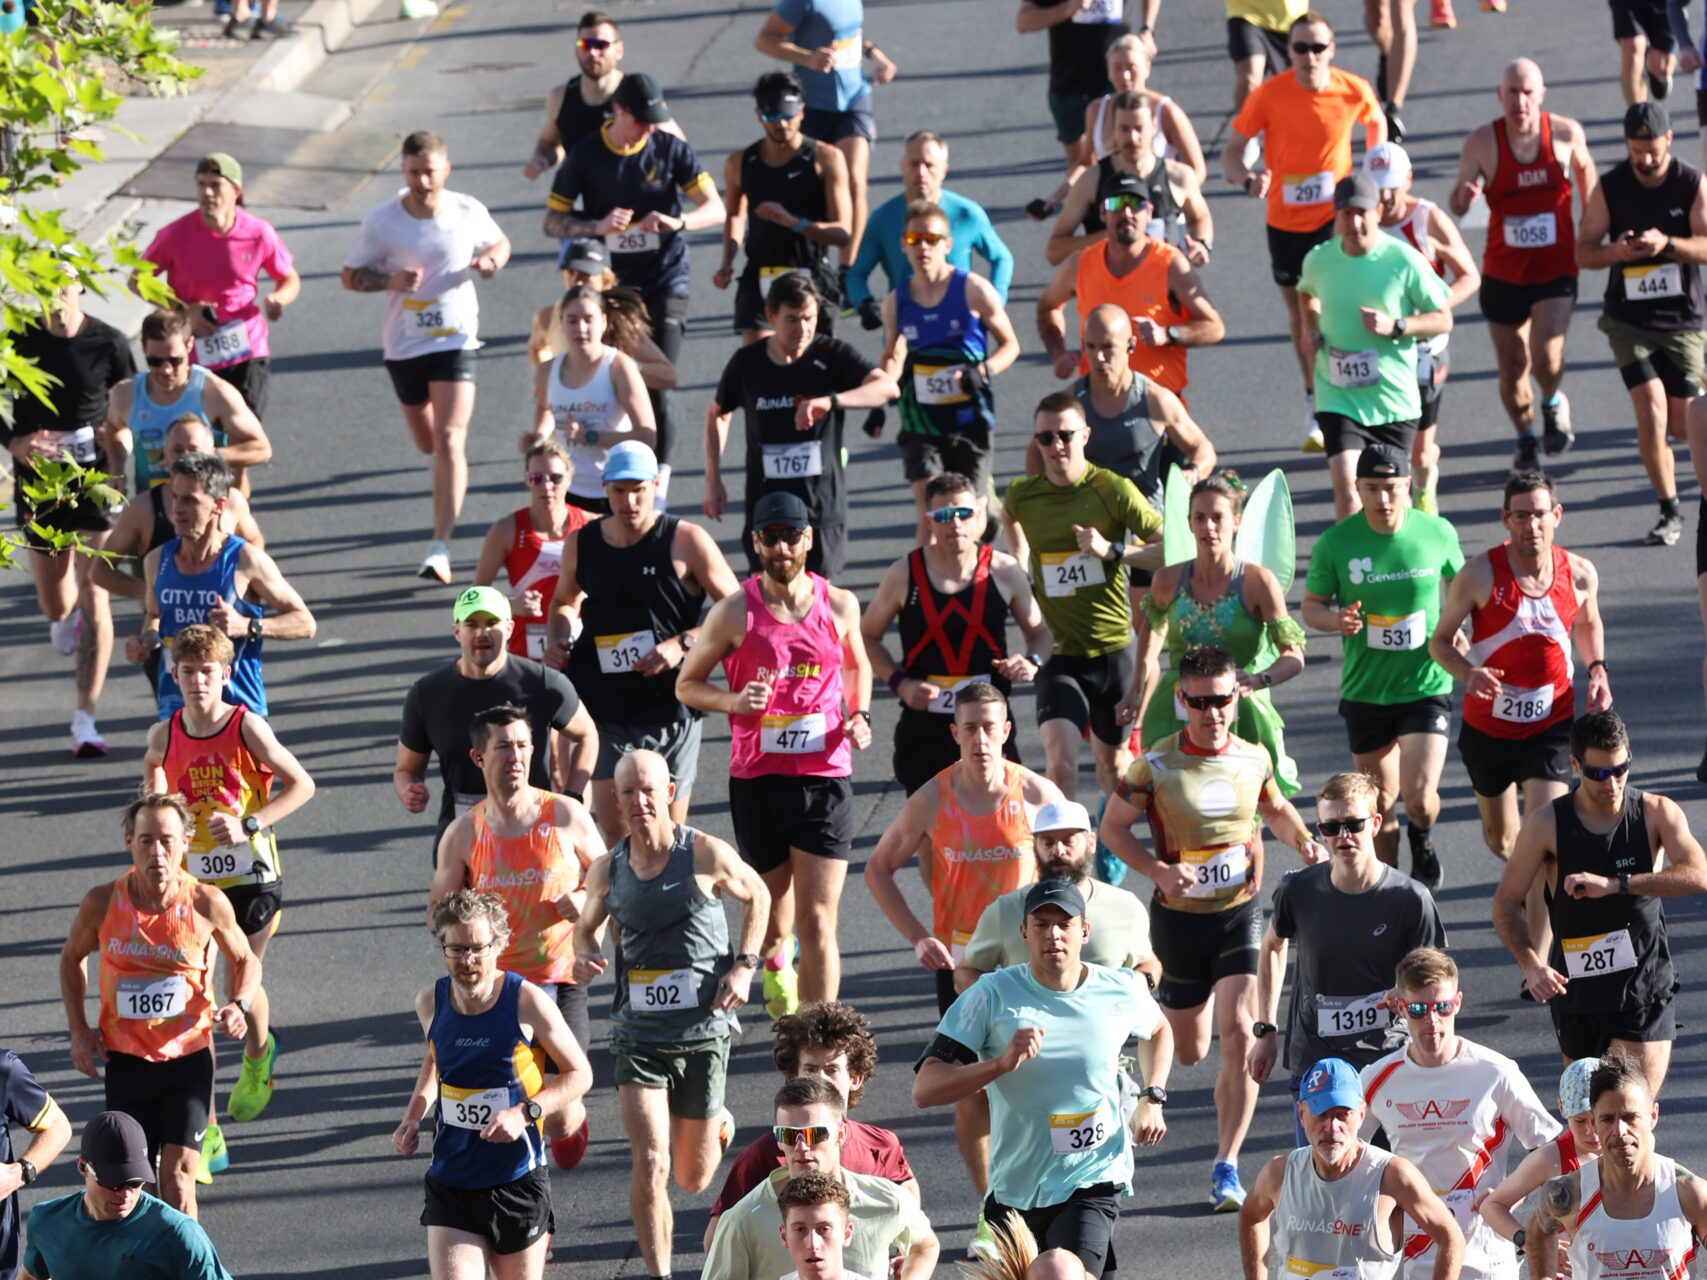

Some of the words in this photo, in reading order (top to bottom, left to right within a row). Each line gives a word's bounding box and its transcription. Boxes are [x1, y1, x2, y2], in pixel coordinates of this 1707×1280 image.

[1295, 184, 1322, 203] 297
[617, 235, 647, 250] 263
[1512, 226, 1549, 243] 1058
[1637, 277, 1669, 294] 444
[415, 312, 445, 328] 326
[1336, 360, 1370, 378] 1413
[926, 377, 954, 394] 521
[773, 454, 811, 474] 1767
[1056, 564, 1087, 584] 241
[1367, 567, 1435, 584] GenesisCare
[160, 588, 194, 605] CITY
[198, 590, 218, 606] TO
[174, 608, 206, 624] BAY
[1382, 628, 1411, 647] 531
[610, 647, 641, 668] 313
[1502, 697, 1544, 718] 2188
[777, 730, 810, 749] 477
[188, 765, 224, 780] RUN
[200, 854, 236, 874] 309
[1616, 857, 1636, 869] SRC
[1198, 863, 1231, 885] 310
[1580, 947, 1616, 972] 287
[128, 992, 176, 1014] 1867
[645, 984, 682, 1006] 502
[1331, 1006, 1378, 1031] 1319
[455, 1102, 493, 1126] 352
[1069, 1123, 1104, 1150] 328
